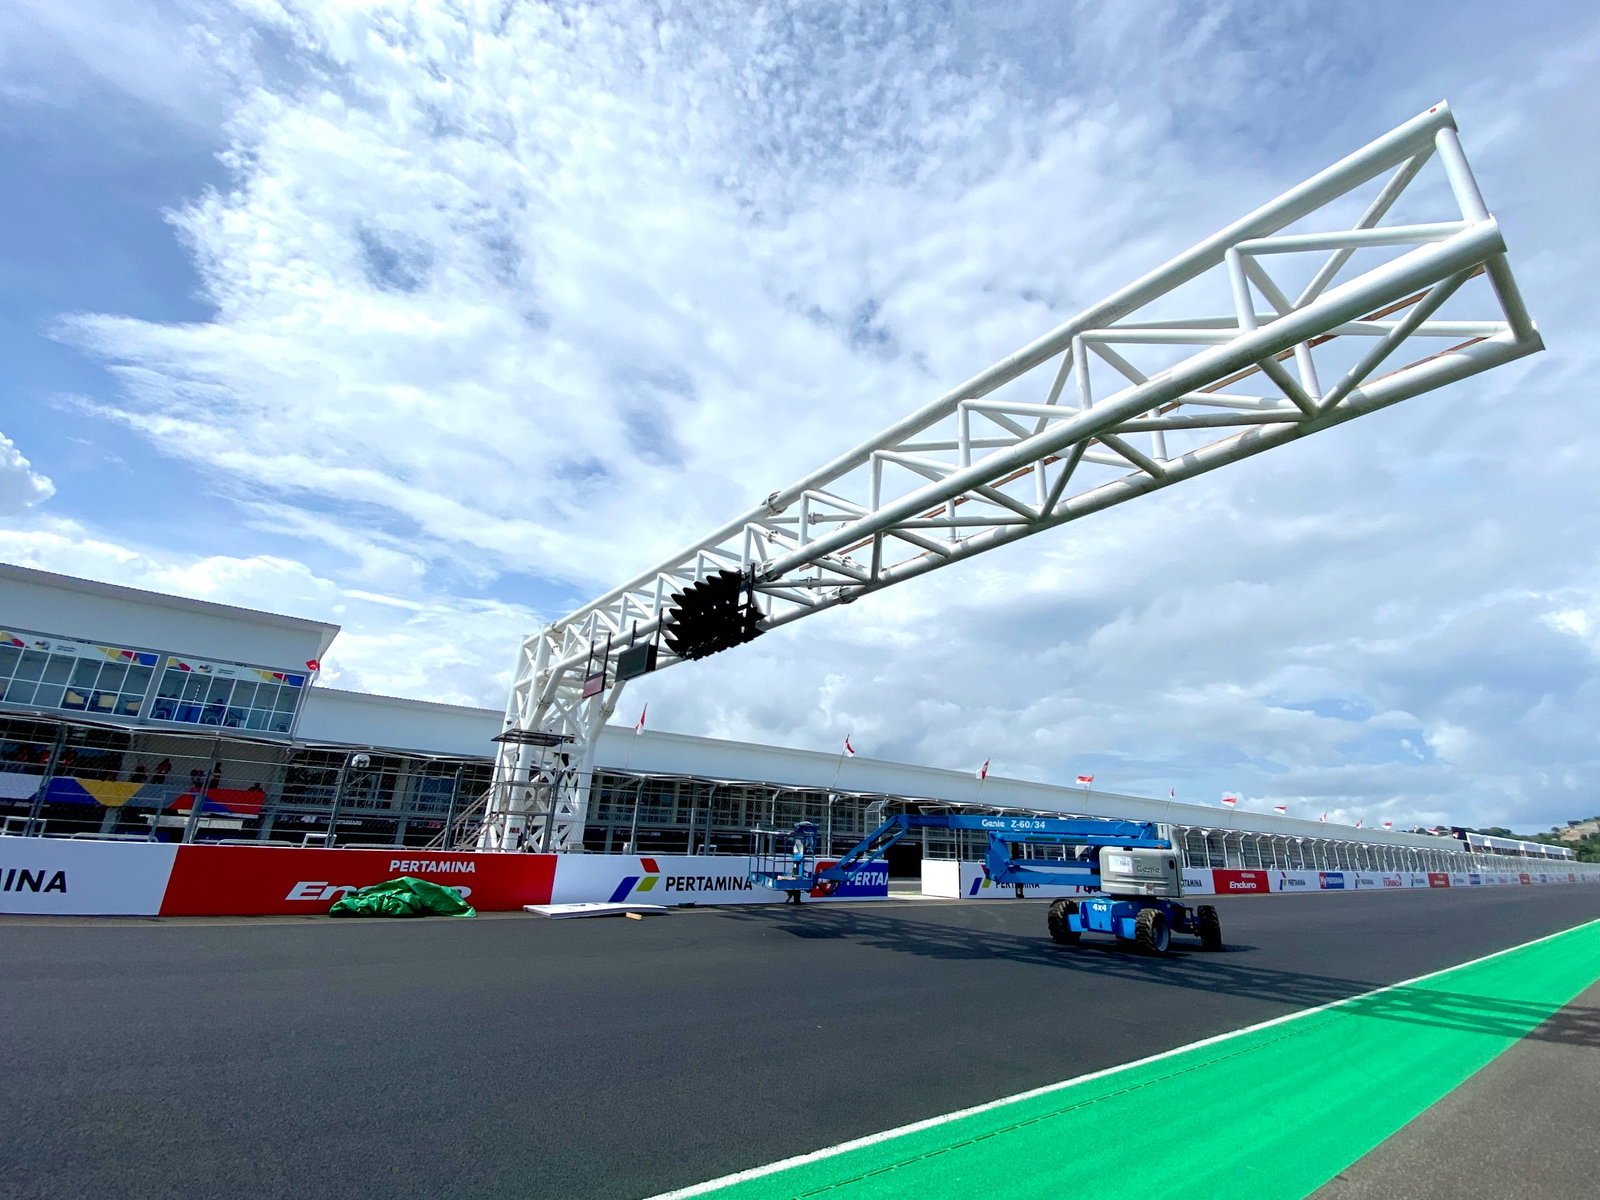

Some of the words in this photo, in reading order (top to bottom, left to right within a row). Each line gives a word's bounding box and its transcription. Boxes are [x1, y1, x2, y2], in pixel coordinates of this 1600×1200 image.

[981, 819, 1005, 828] Genie
[1010, 820, 1046, 829] Z-60/34
[389, 860, 476, 873] PERTAMINA
[1137, 865, 1161, 873] Genie
[0, 868, 67, 893] INA
[665, 876, 753, 892] PERTAMINA
[846, 871, 888, 886] PERTA
[1229, 881, 1257, 889] Enduro
[284, 881, 472, 901] Eno
[1092, 903, 1107, 912] 4x4
